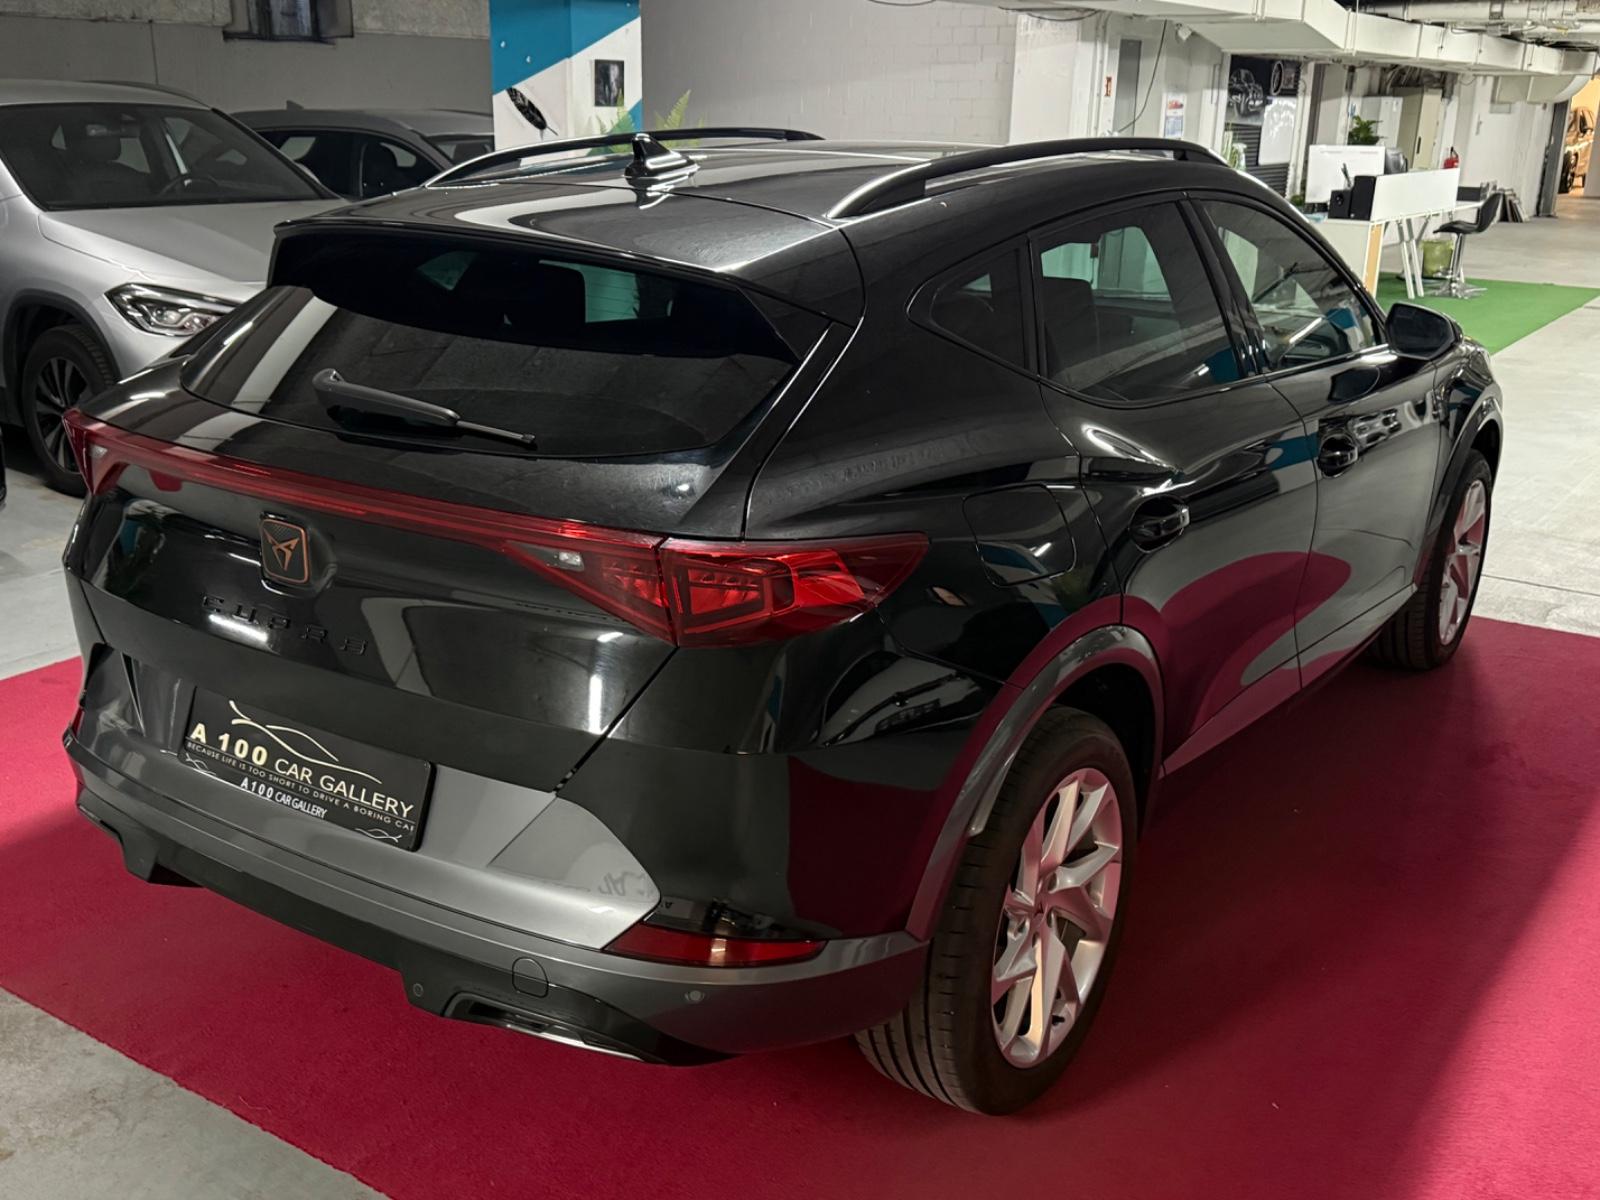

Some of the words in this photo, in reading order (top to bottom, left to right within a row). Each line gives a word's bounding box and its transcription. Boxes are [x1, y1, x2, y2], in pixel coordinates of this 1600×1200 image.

[187, 742, 220, 760] BECAUSE
[222, 756, 236, 767] LIFE
[239, 762, 246, 770] IS
[248, 765, 266, 778] TOO
[268, 774, 296, 790] SHORT
[298, 784, 310, 794] TO
[313, 788, 339, 805] DRIVE
[343, 801, 350, 809] A
[353, 805, 391, 824] BORING
[190, 722, 206, 744] A
[218, 732, 268, 766] 100
[274, 758, 312, 784] CAR
[320, 775, 414, 818] GALLERY
